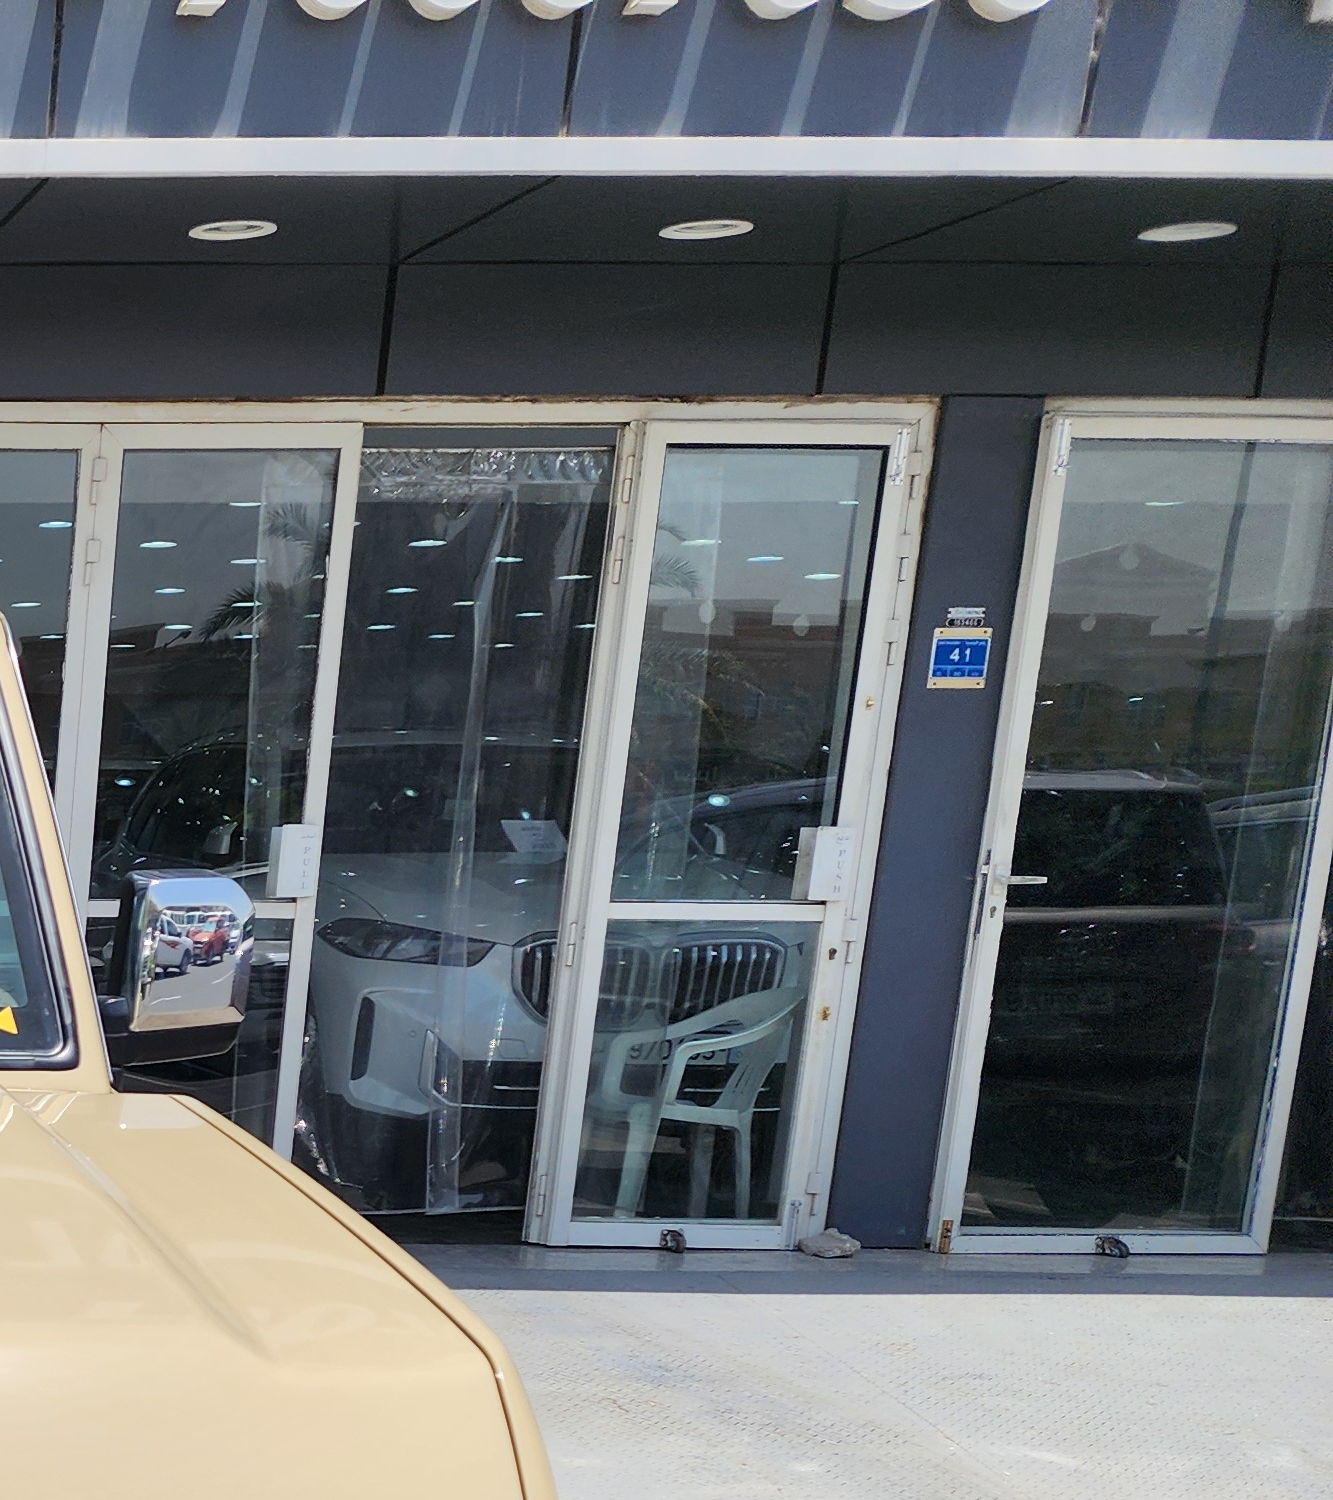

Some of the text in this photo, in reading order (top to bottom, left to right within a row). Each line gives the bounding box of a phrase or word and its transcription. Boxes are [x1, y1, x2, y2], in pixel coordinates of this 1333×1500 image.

[949, 647, 971, 663] 41
[300, 846, 311, 890] PULL
[833, 849, 846, 894] PUSH
